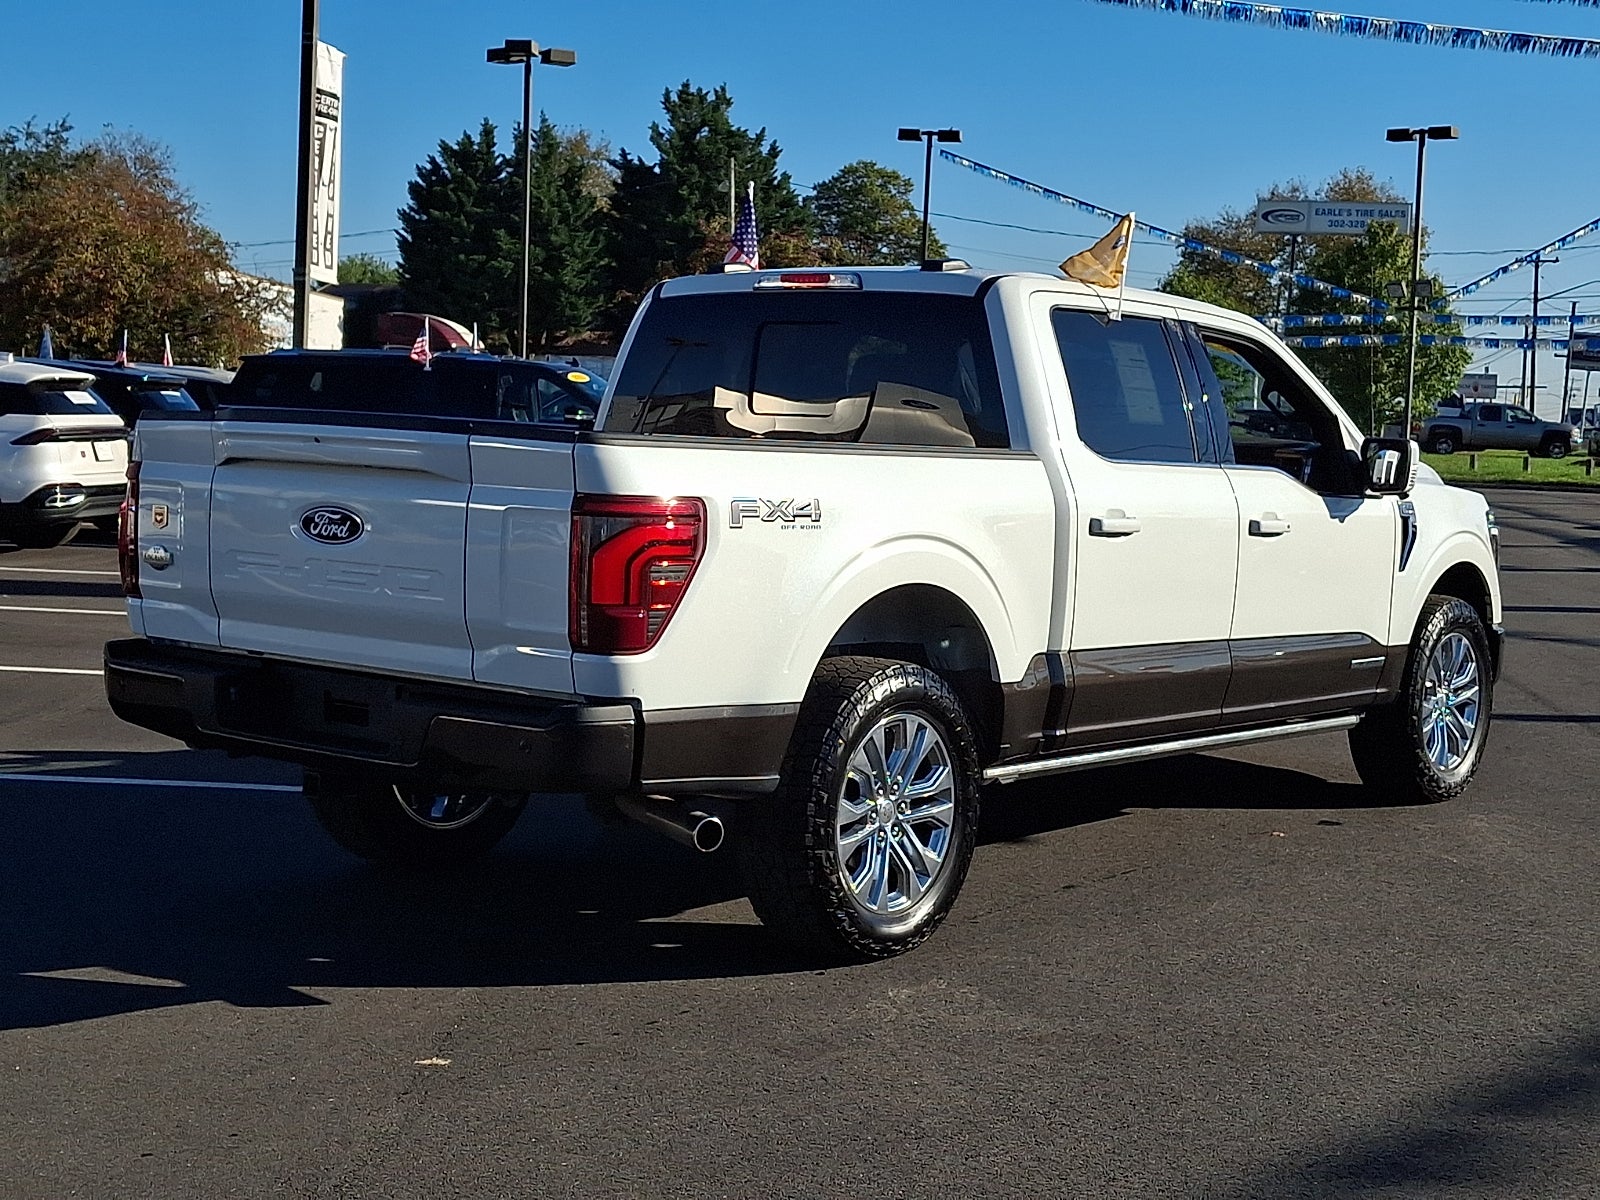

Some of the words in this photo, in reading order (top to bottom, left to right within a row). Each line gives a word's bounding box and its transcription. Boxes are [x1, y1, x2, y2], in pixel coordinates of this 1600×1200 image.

[1315, 208, 1352, 217] EARLE'S
[1355, 209, 1375, 217] TIRE
[1378, 210, 1406, 218] SALES
[310, 511, 351, 538] Ford
[729, 496, 821, 529] FX4
